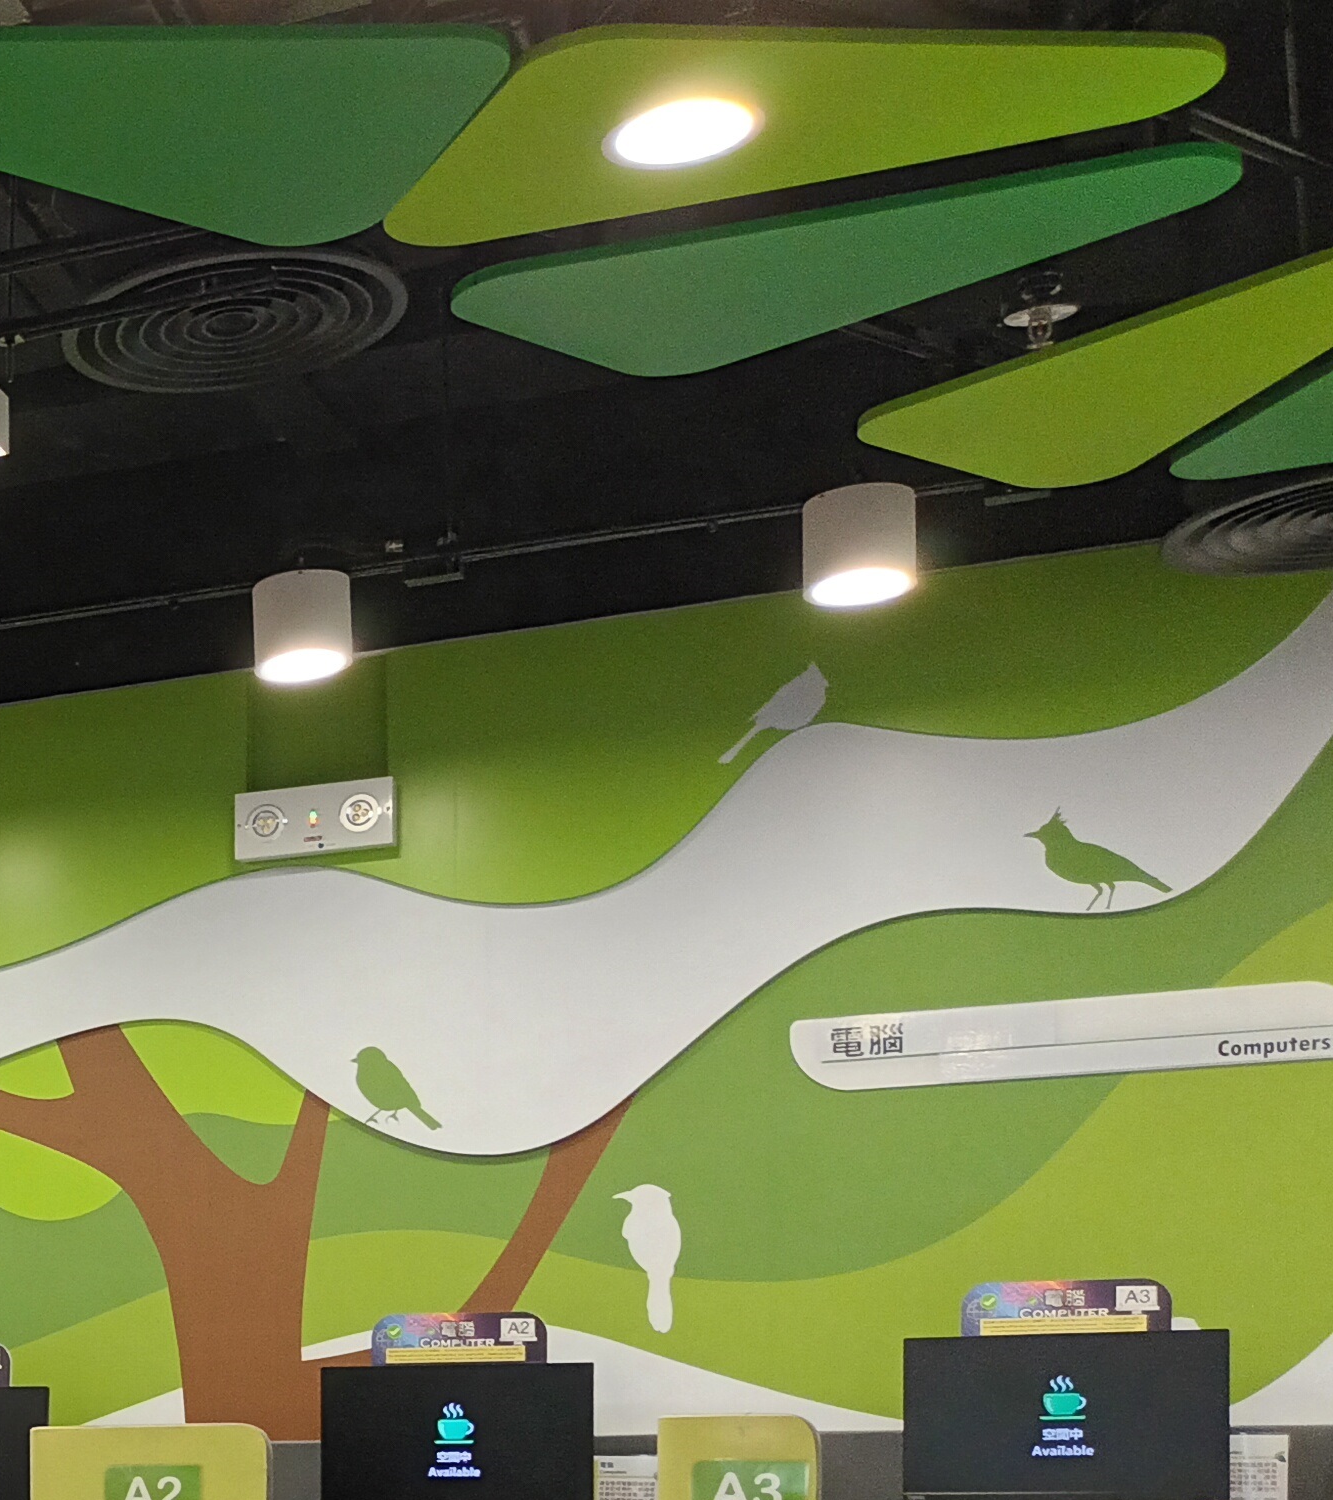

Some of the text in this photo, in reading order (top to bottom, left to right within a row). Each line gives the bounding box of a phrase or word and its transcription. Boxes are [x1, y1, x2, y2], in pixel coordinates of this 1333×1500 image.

[829, 1021, 905, 1059] 電腦
[1217, 1034, 1332, 1059] Computers
[1124, 1289, 1152, 1305] A3
[1018, 1307, 1110, 1319] COMPUTER
[507, 1321, 530, 1335] A2
[419, 1337, 496, 1349] COMPUTER
[1030, 1444, 1096, 1458] Available
[426, 1466, 482, 1478] Available
